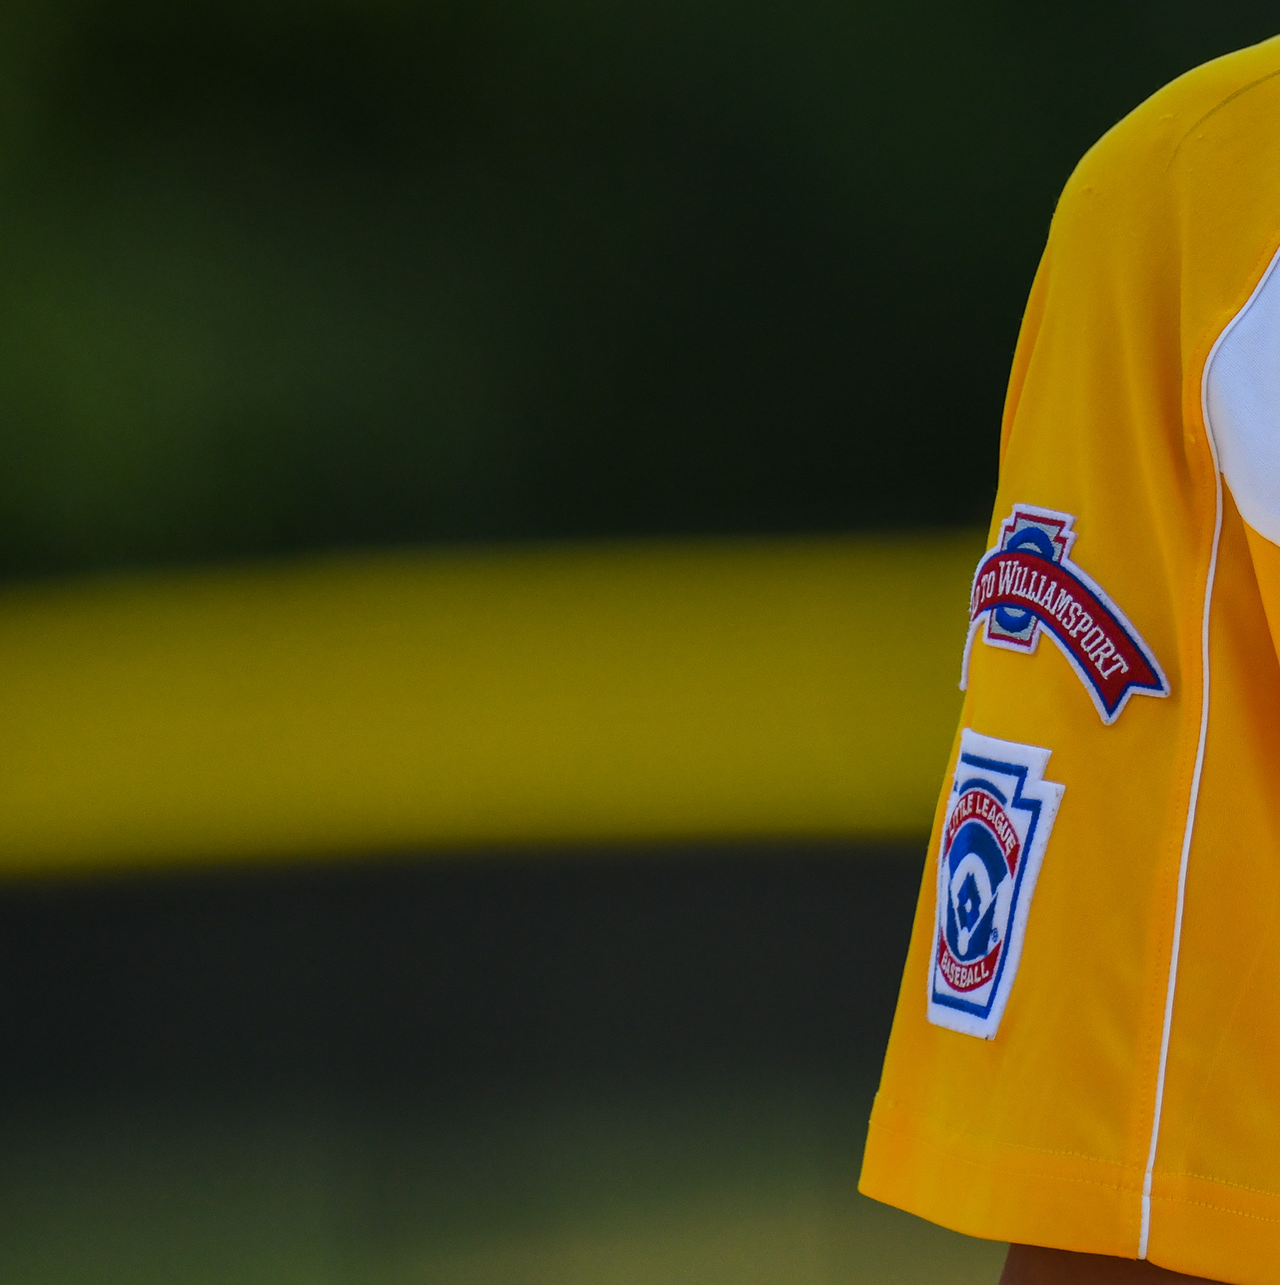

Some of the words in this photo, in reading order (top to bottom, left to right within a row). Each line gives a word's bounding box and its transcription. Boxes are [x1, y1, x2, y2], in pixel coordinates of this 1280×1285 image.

[981, 570, 995, 603] TO
[998, 560, 1129, 680] WILLIAMSPORT
[976, 795, 1017, 856] LEAGUE
[940, 950, 990, 989] BASEBALL
